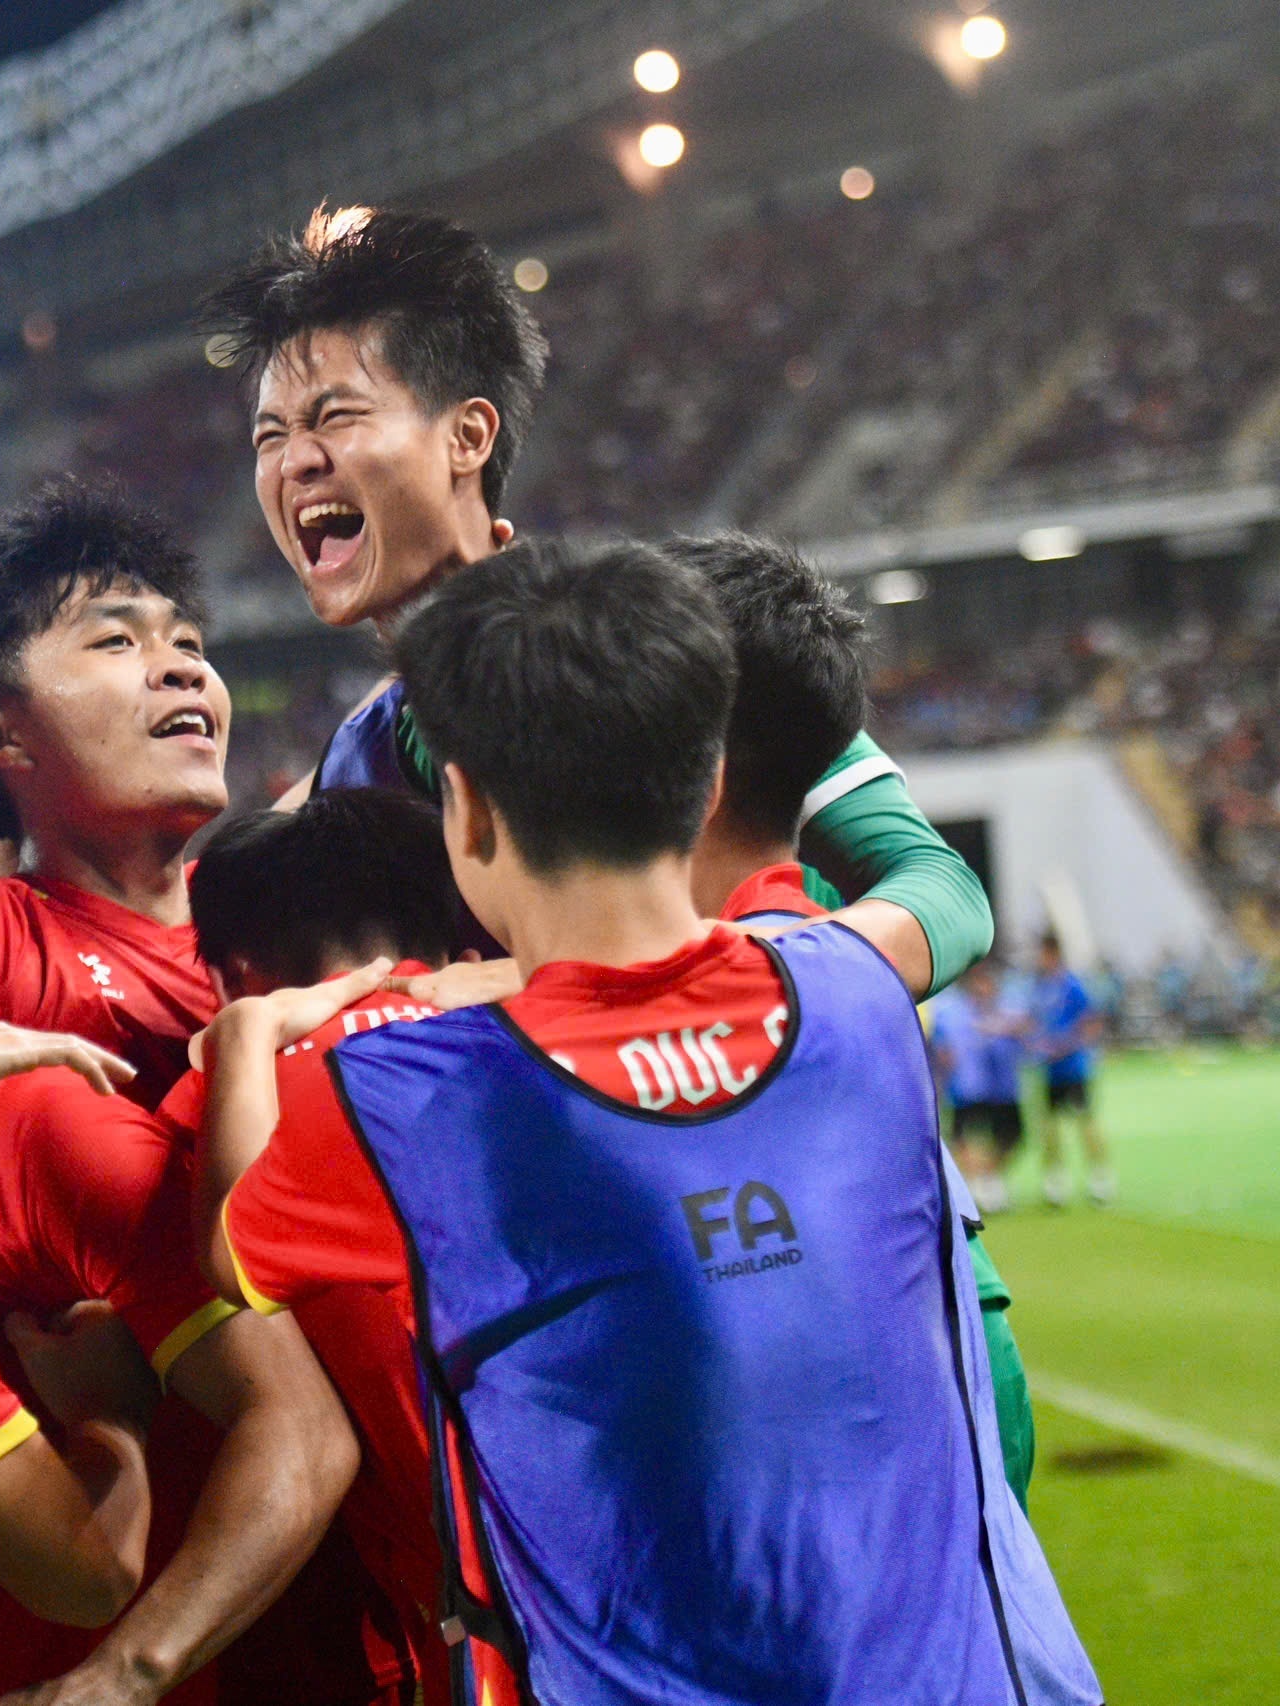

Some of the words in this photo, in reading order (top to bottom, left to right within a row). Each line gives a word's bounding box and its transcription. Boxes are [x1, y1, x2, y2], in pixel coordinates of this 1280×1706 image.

[616, 1021, 757, 1111] DUC
[679, 1180, 798, 1262] FA
[702, 1248, 803, 1284] THAILAND
